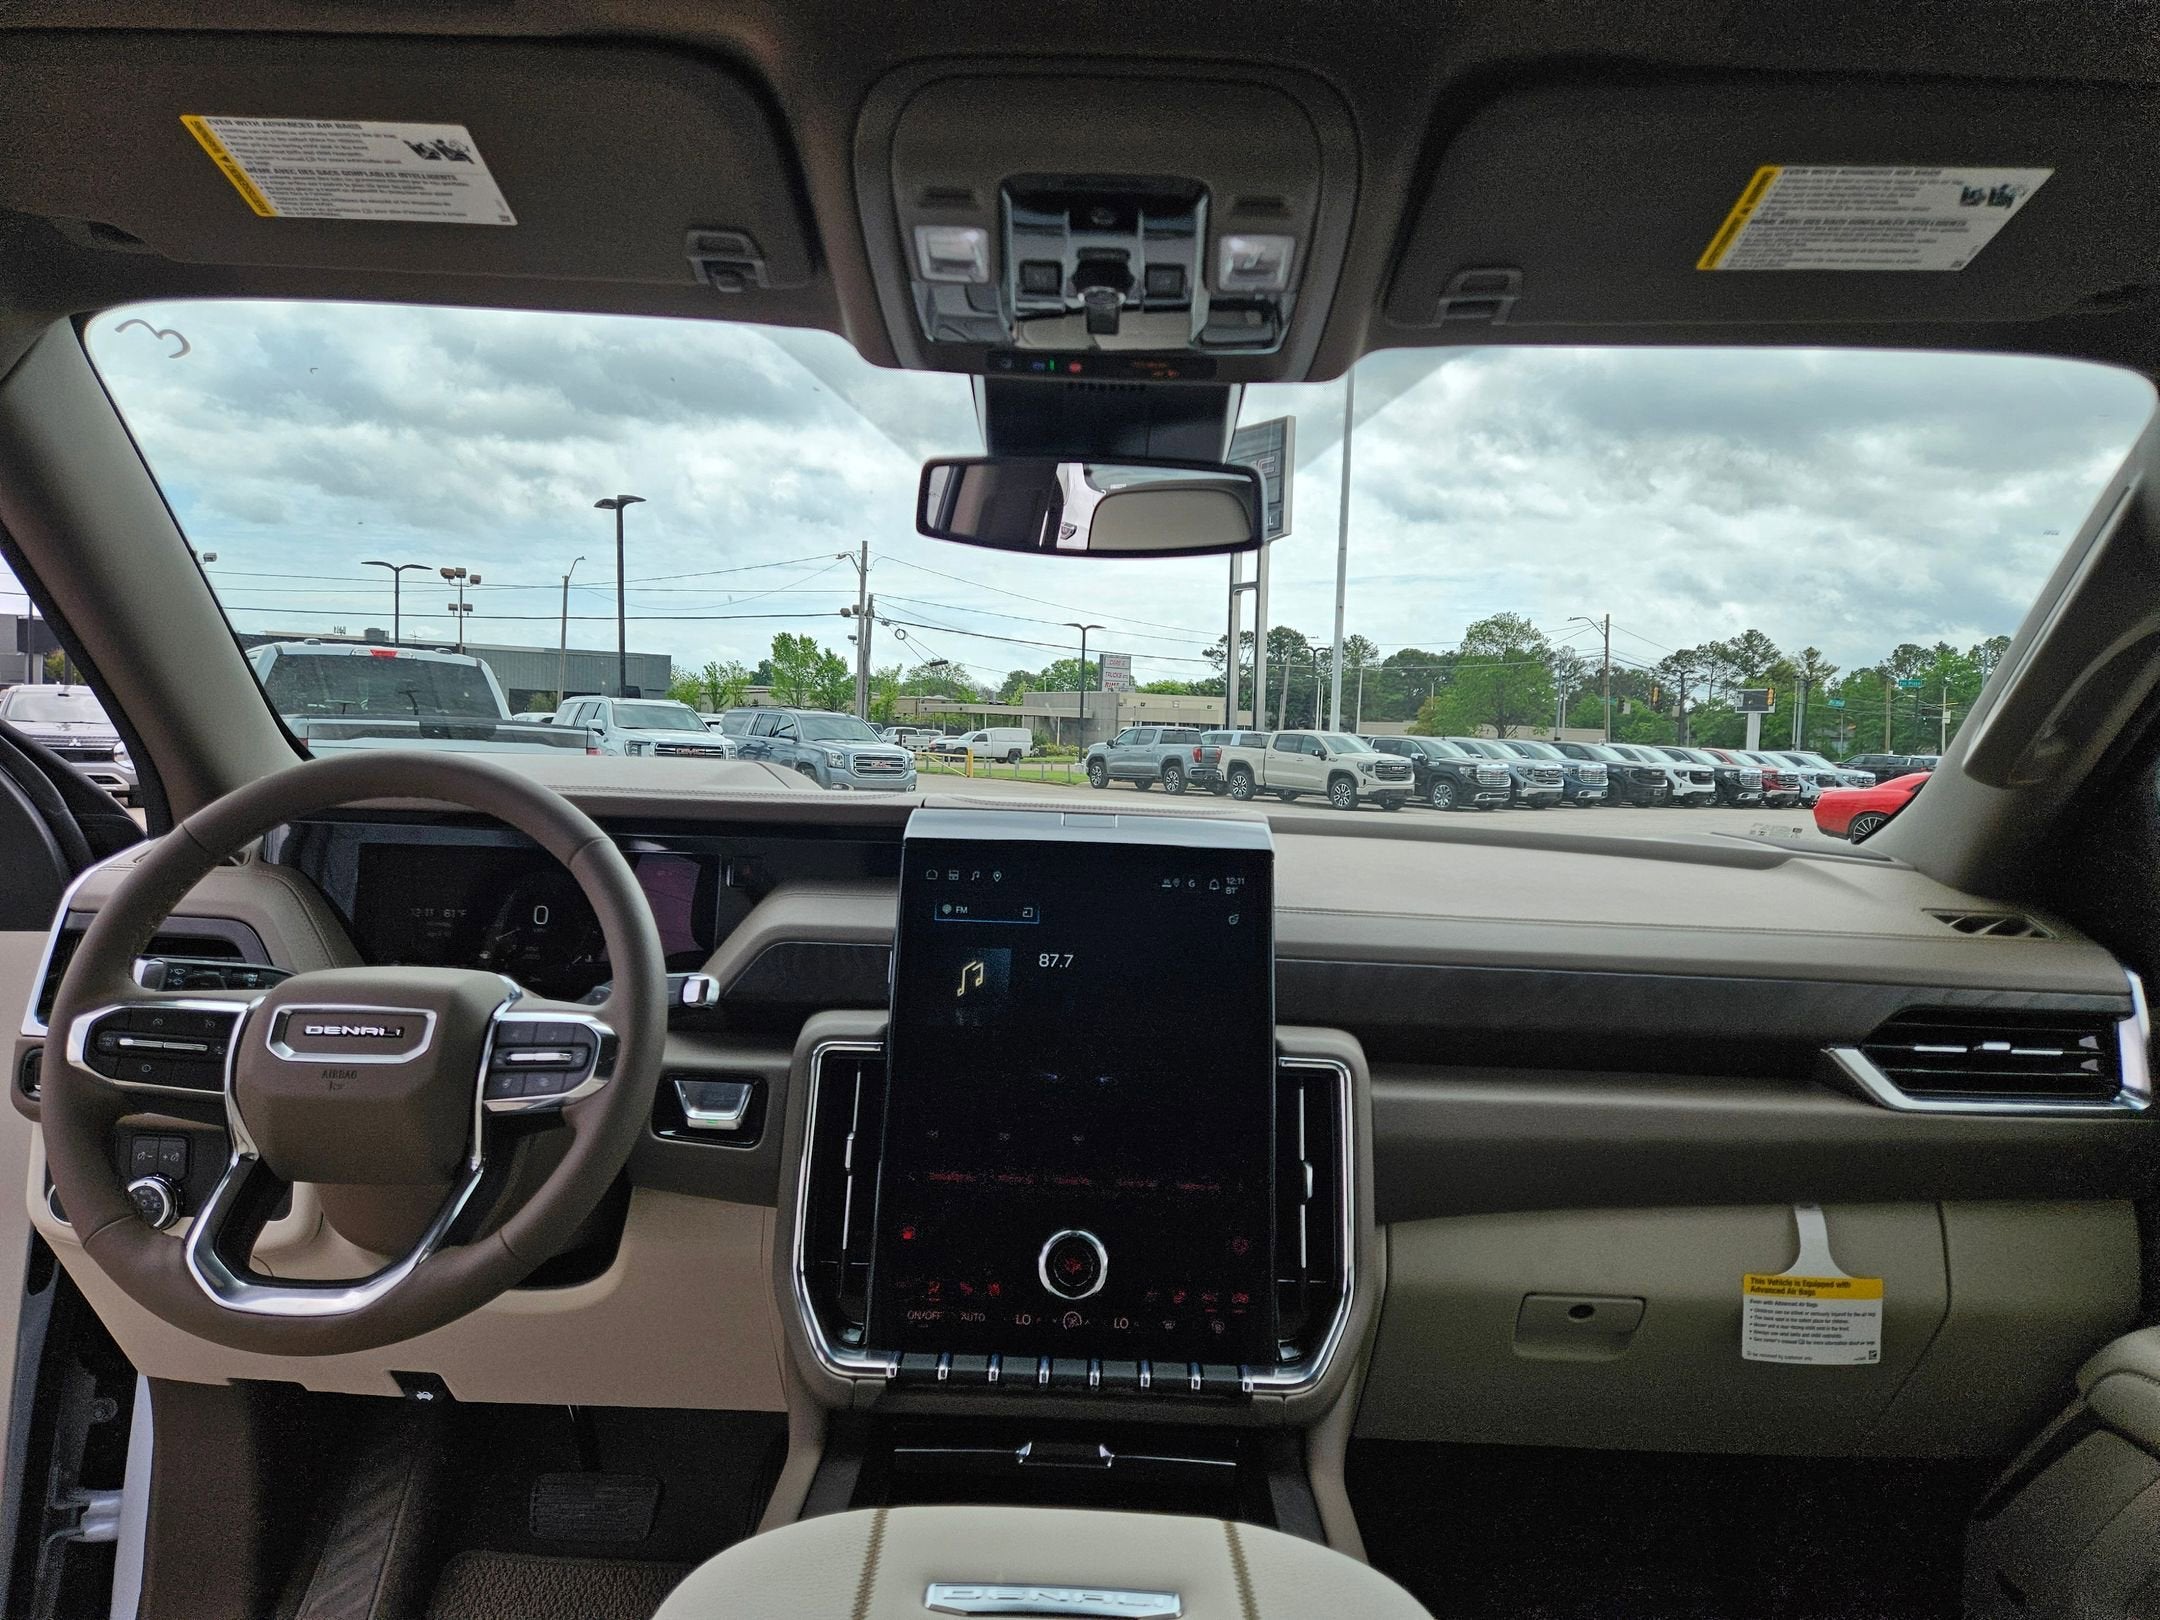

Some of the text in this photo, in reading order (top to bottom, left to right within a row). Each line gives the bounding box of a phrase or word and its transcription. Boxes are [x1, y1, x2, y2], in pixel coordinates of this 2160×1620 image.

[955, 905, 968, 914] FM
[1038, 953, 1074, 968] 87.7
[304, 1025, 404, 1037] DENALI
[321, 1069, 358, 1079] AIRBAG
[1750, 1276, 1765, 1285] This
[1767, 1277, 1791, 1286] Vehicle
[1802, 1279, 1834, 1288] Equipped
[1836, 1280, 1851, 1288] with
[1750, 1285, 1785, 1294] Advanced
[1787, 1287, 1797, 1295] Air
[1015, 1314, 1032, 1325] LO
[1113, 1317, 1129, 1329] LO
